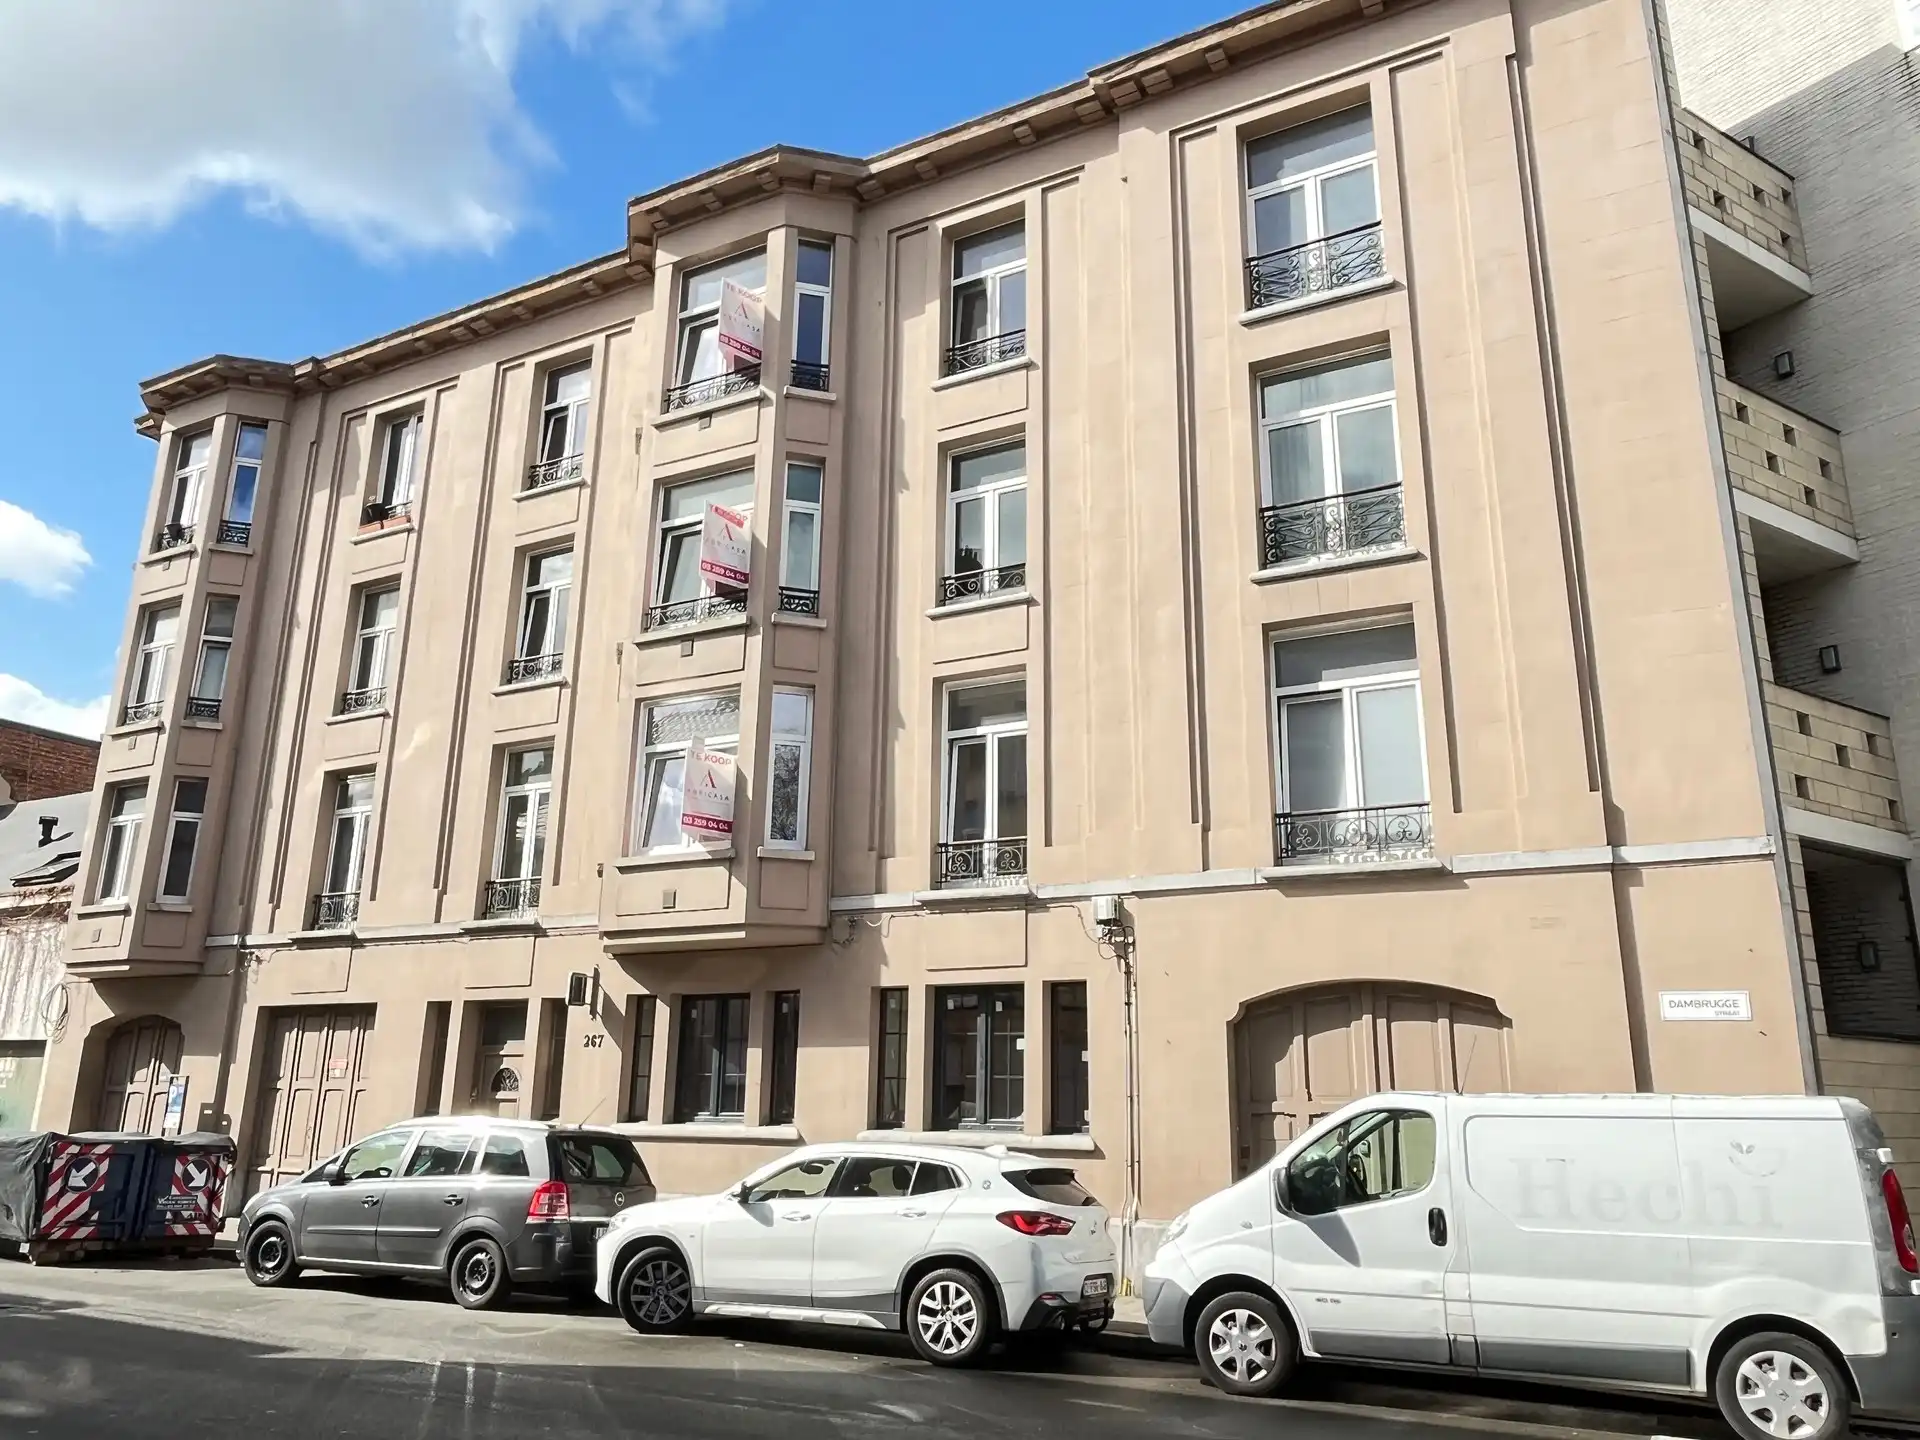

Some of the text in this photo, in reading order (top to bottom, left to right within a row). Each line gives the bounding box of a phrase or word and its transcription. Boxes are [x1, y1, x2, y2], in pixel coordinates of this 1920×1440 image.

[725, 569, 735, 578] 04
[690, 750, 732, 765] TE KOOP
[683, 816, 729, 830] 03 259 04 04
[1668, 999, 1740, 1009] DAMBRUGGE
[583, 1034, 605, 1048] 267
[1508, 1157, 1783, 1230] Hechi
